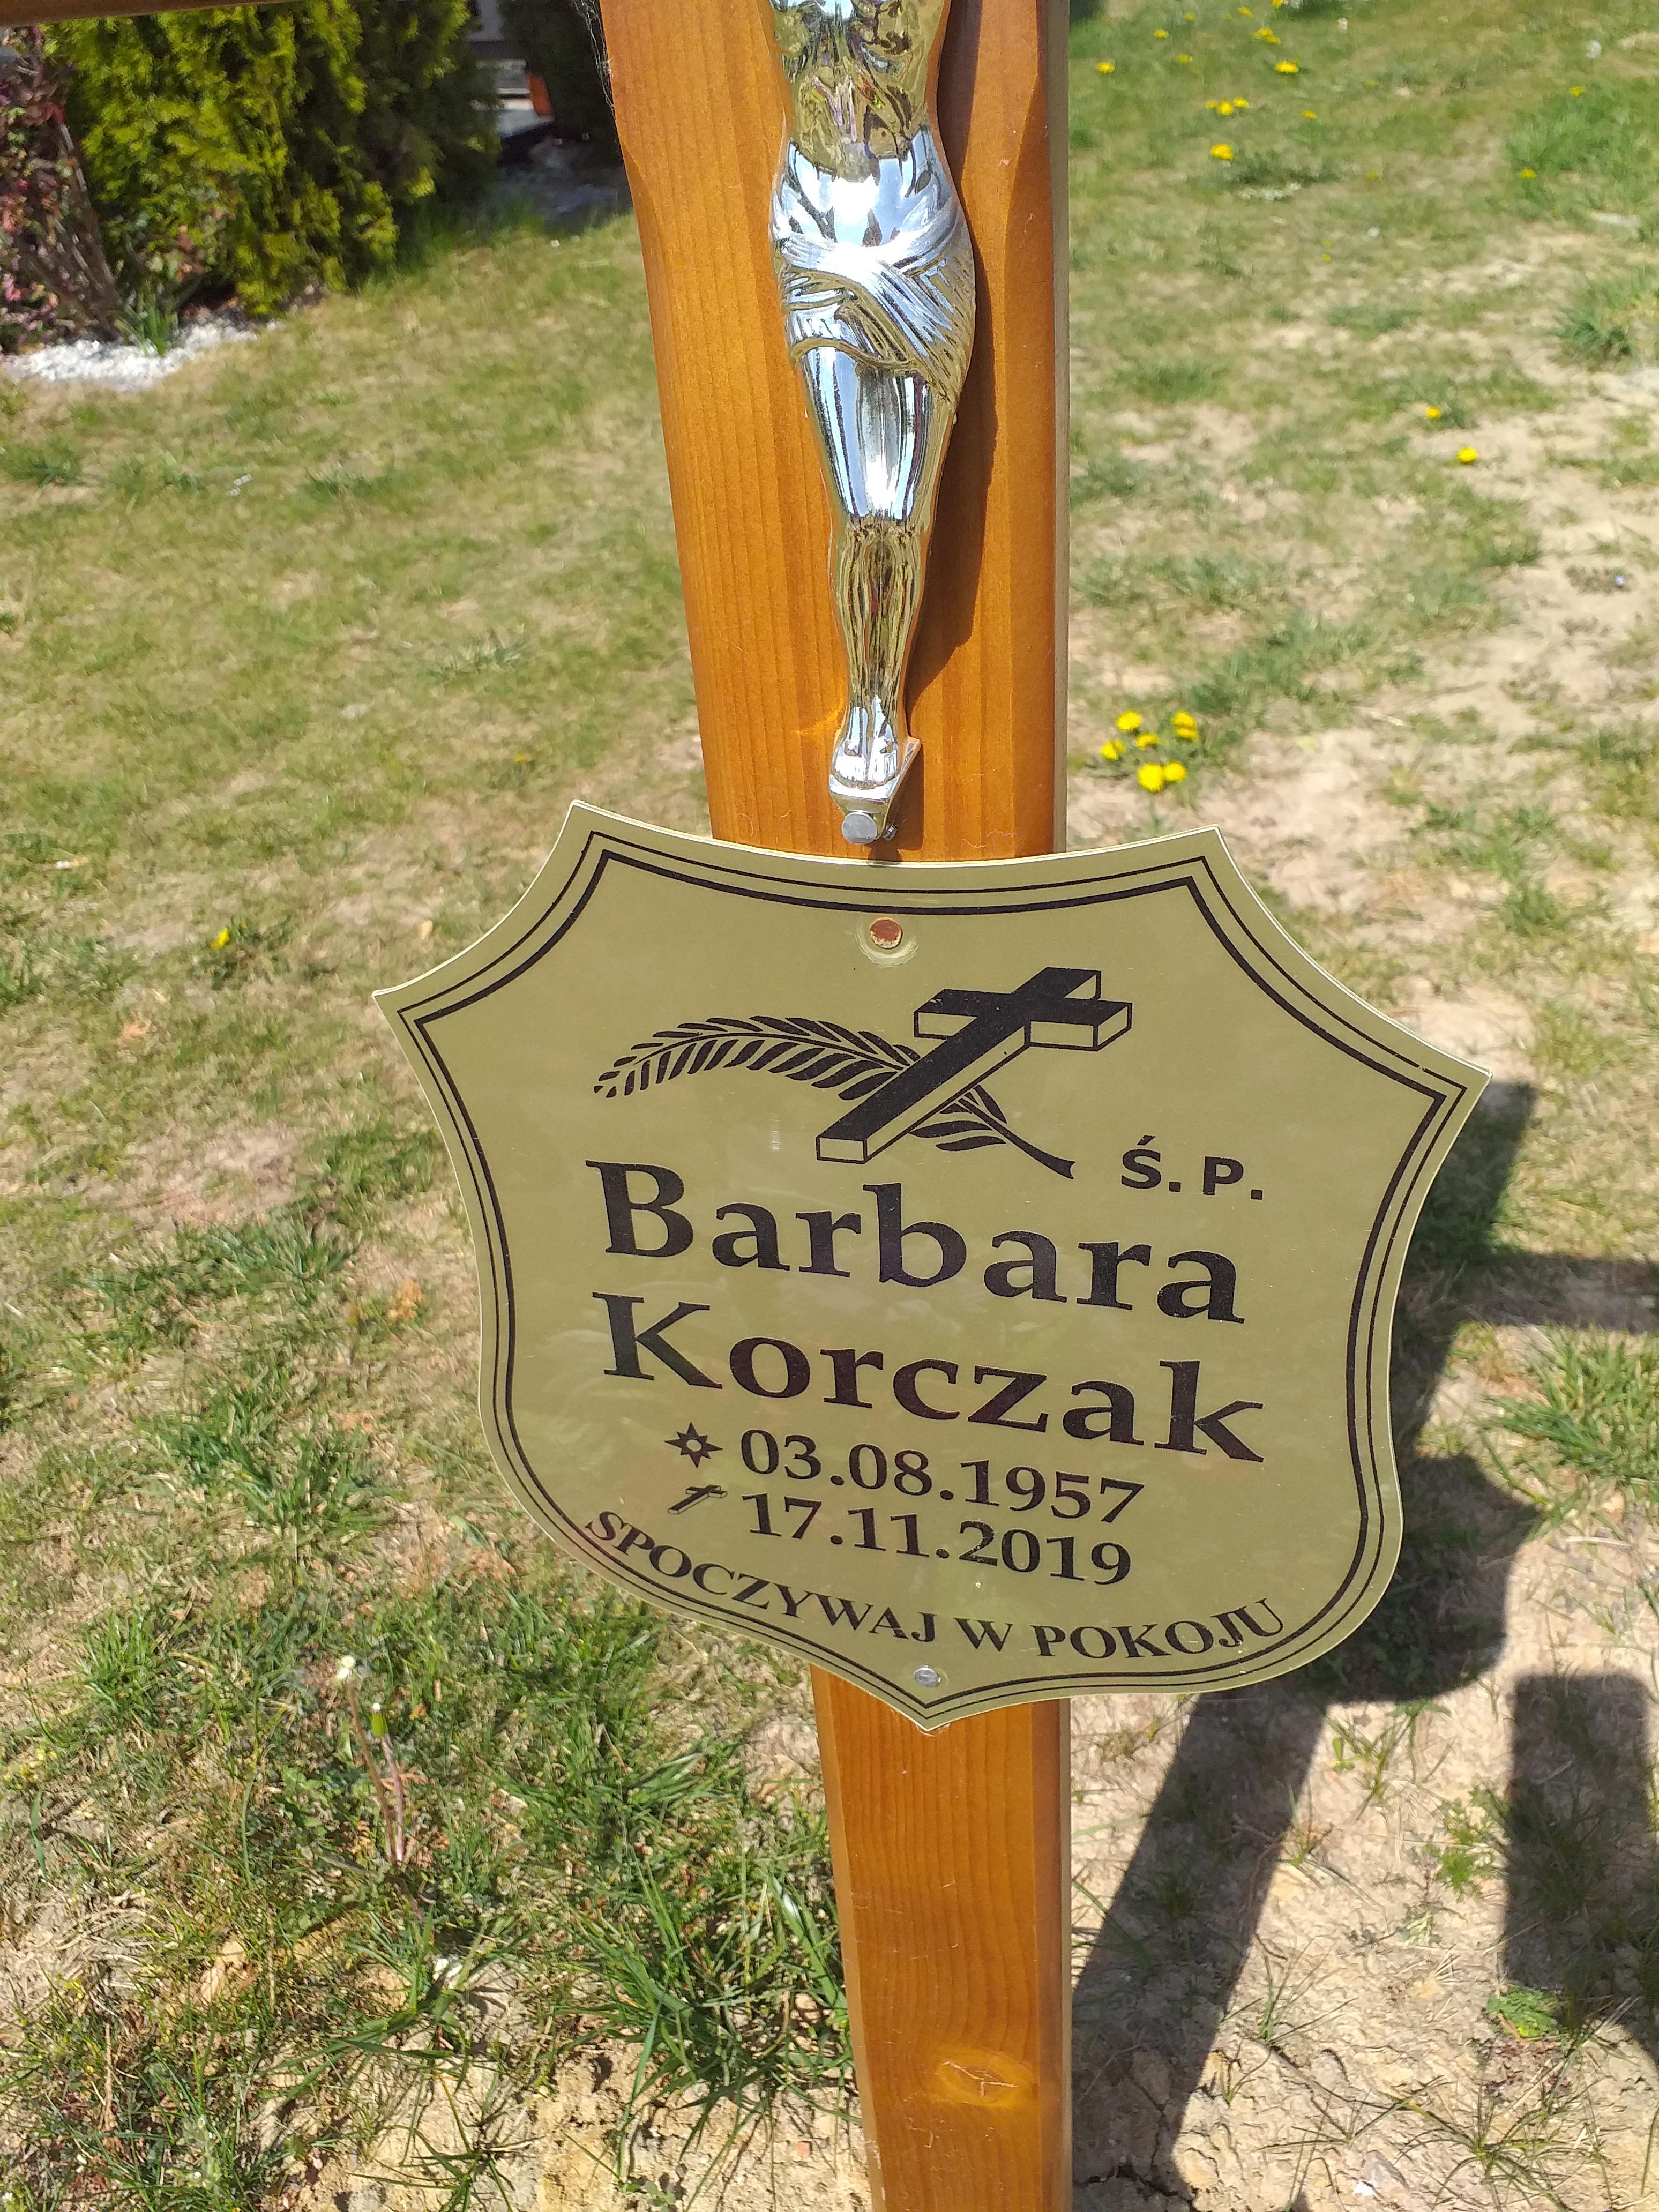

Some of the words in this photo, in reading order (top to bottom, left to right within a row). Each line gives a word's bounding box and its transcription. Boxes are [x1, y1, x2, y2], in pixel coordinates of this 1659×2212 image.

[585, 1159, 1246, 1325] Barbara
[592, 1291, 1265, 1463] Korczak
[740, 1429, 1145, 1524] 03.08.1957
[741, 1492, 1132, 1586] 17.11.2019
[584, 1510, 937, 1643] SPOCZYWAJ
[954, 1617, 1013, 1653] W
[1030, 1598, 1286, 1660] POKOJU
